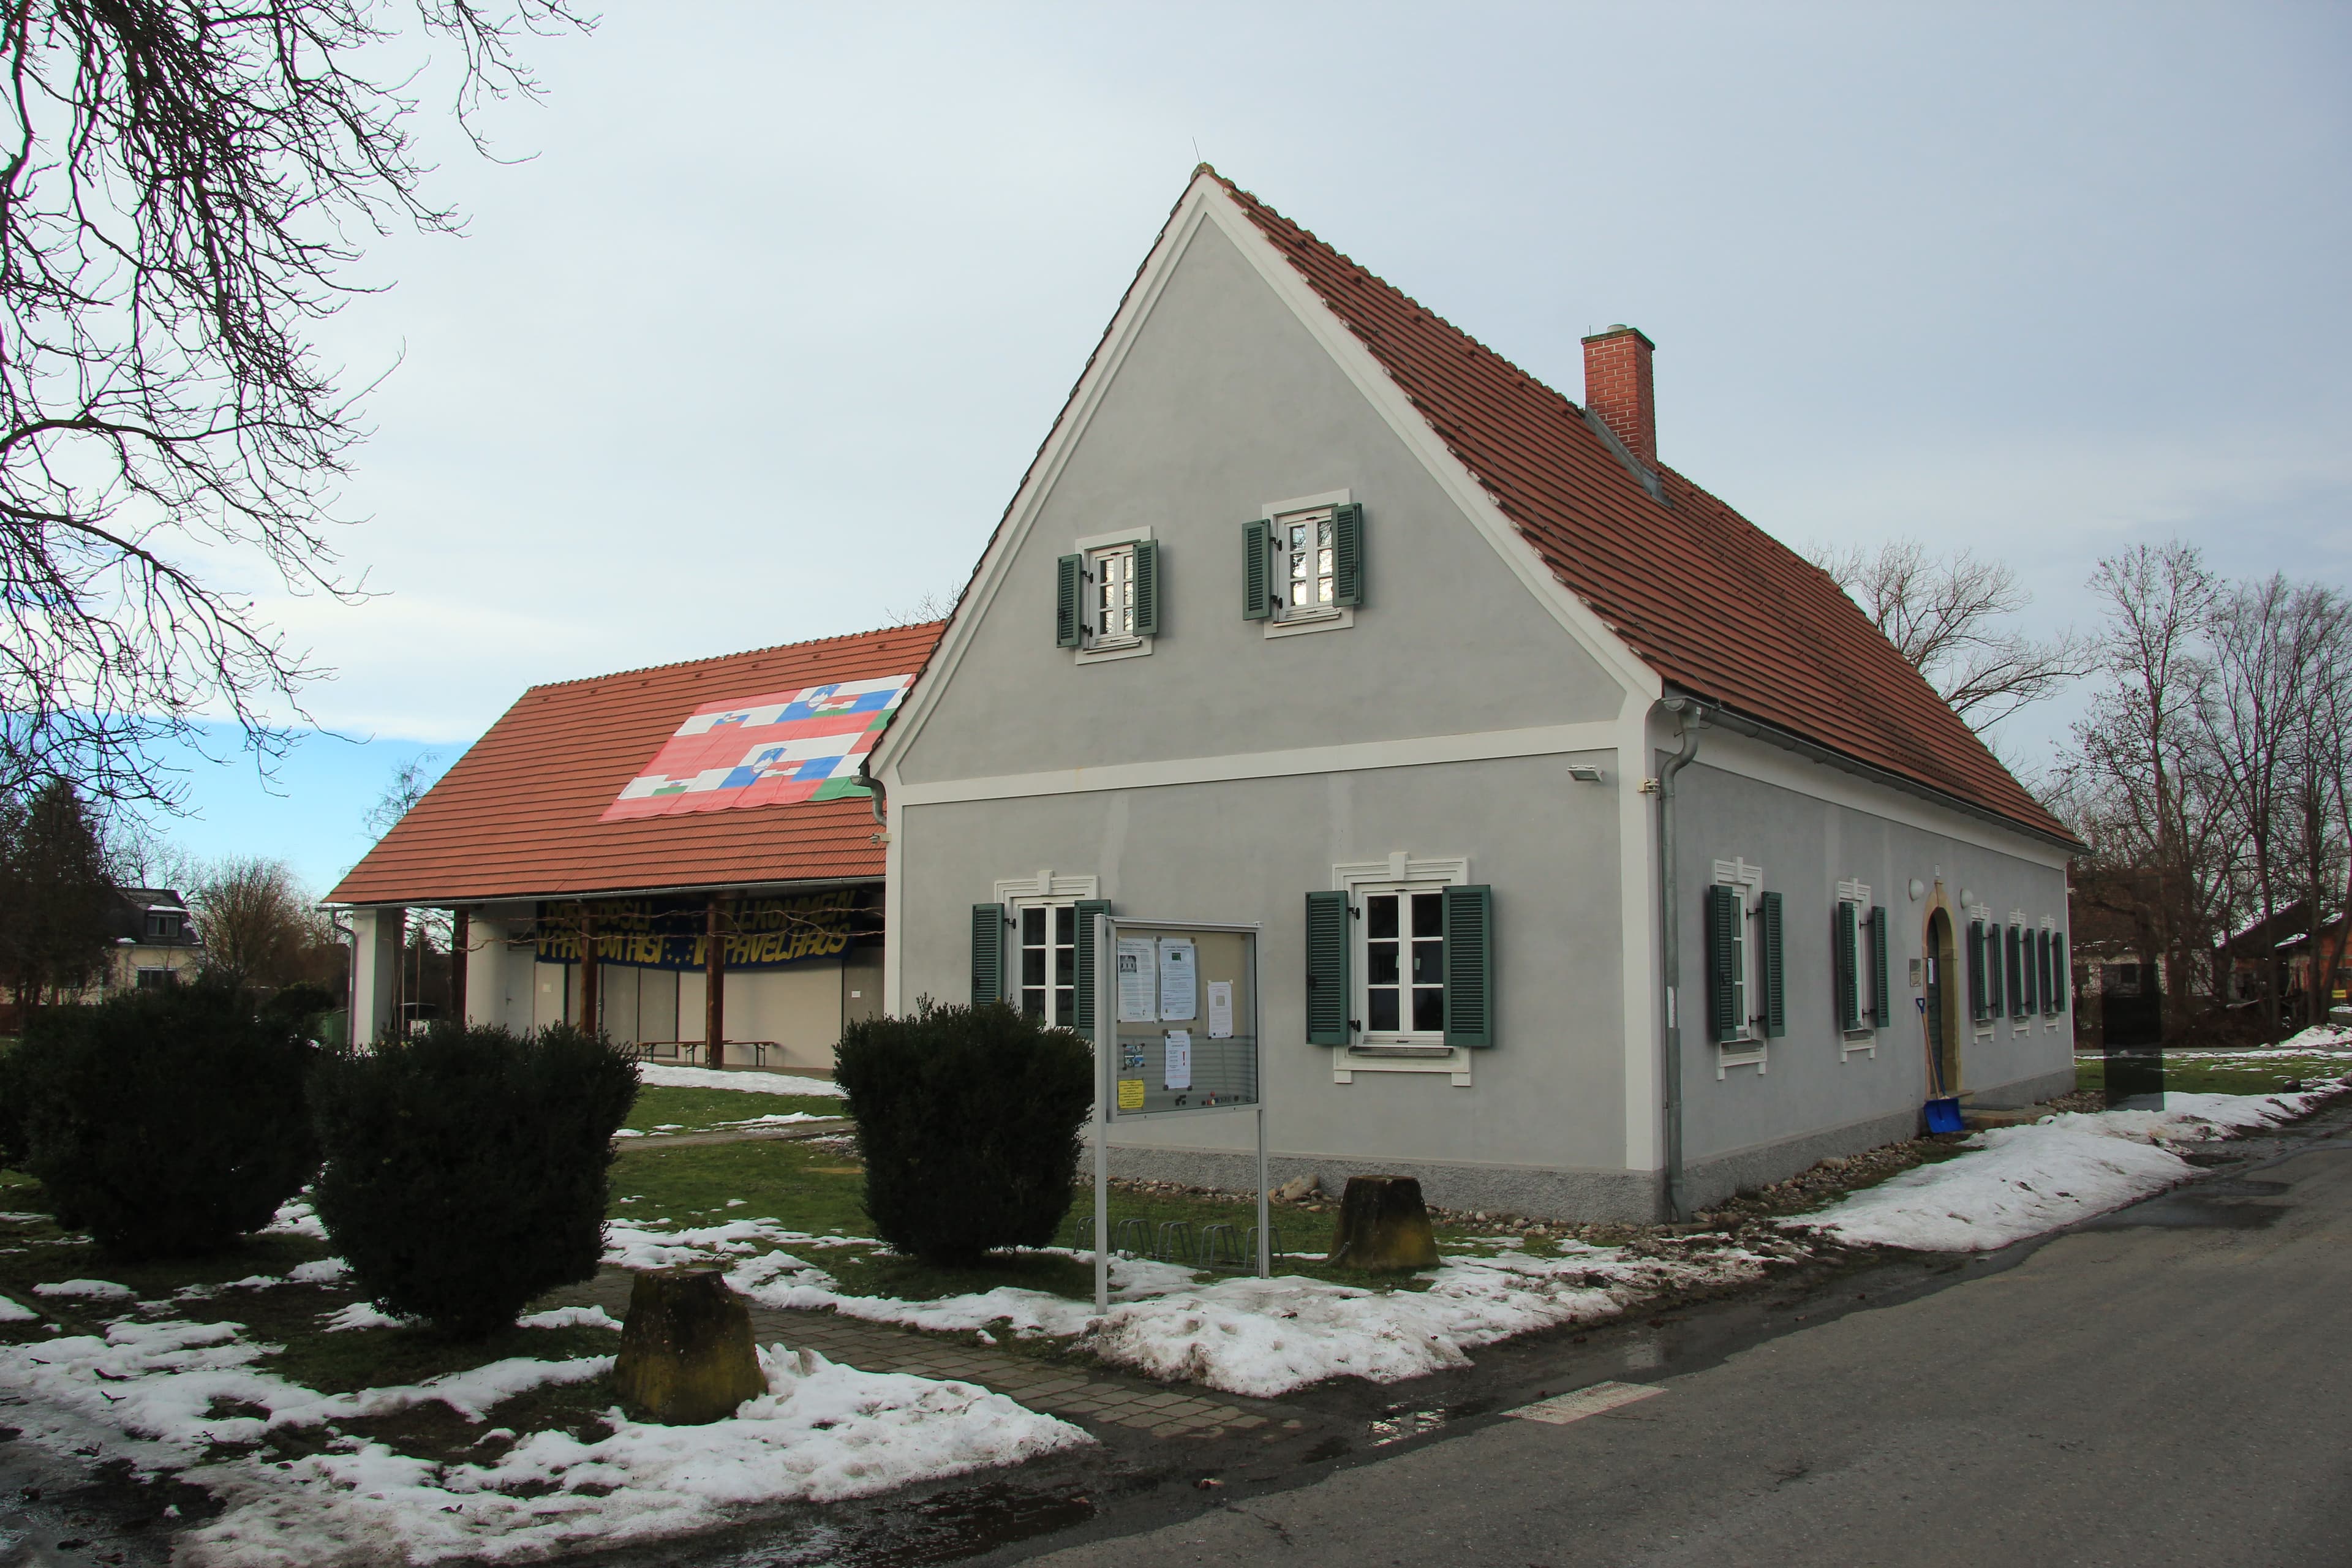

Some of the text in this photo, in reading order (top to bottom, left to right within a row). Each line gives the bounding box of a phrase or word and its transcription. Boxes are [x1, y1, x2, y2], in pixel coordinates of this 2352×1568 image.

[538, 928, 550, 957] V
[625, 929, 664, 963] HIŠI
[723, 922, 851, 965] PAVELHAUS
